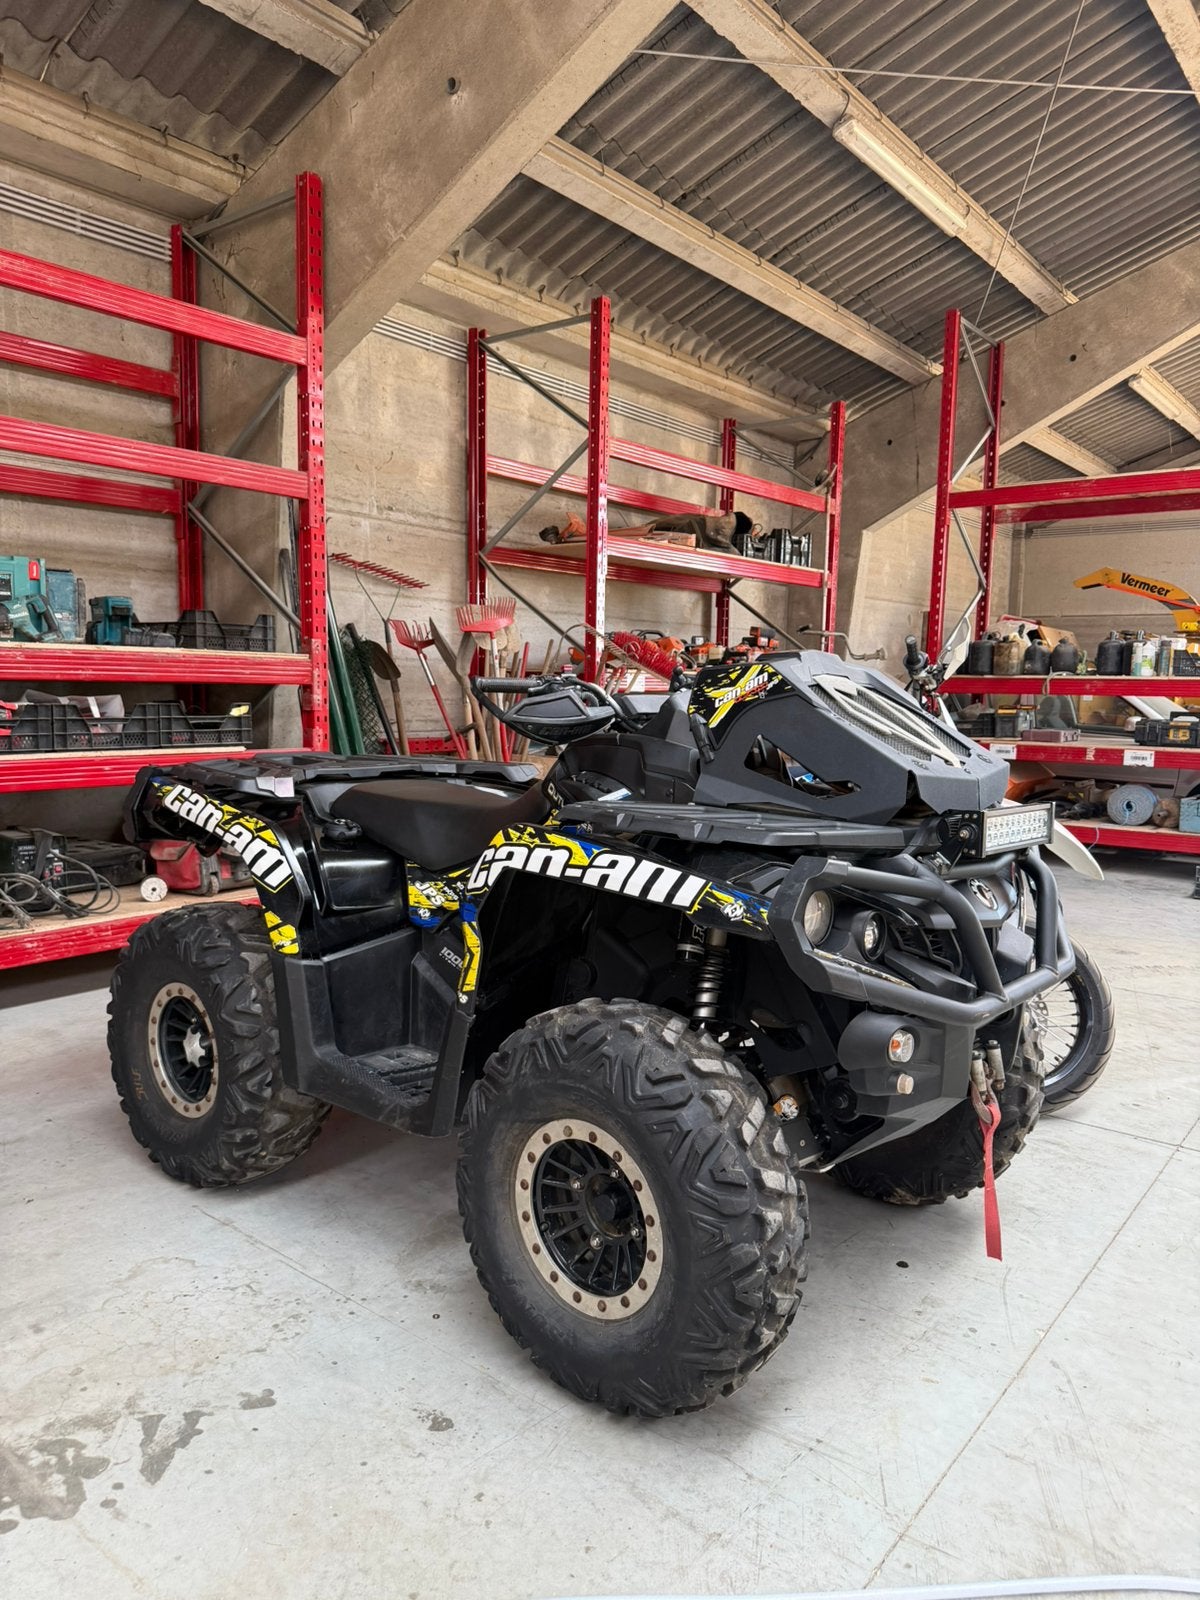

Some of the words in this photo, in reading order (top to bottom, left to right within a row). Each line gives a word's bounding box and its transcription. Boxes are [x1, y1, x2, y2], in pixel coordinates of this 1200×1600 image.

[1120, 572, 1172, 598] Vermeer
[714, 672, 769, 708] can-am
[164, 784, 292, 888] can-am
[414, 881, 446, 907] JPS
[467, 846, 707, 908] can-am
